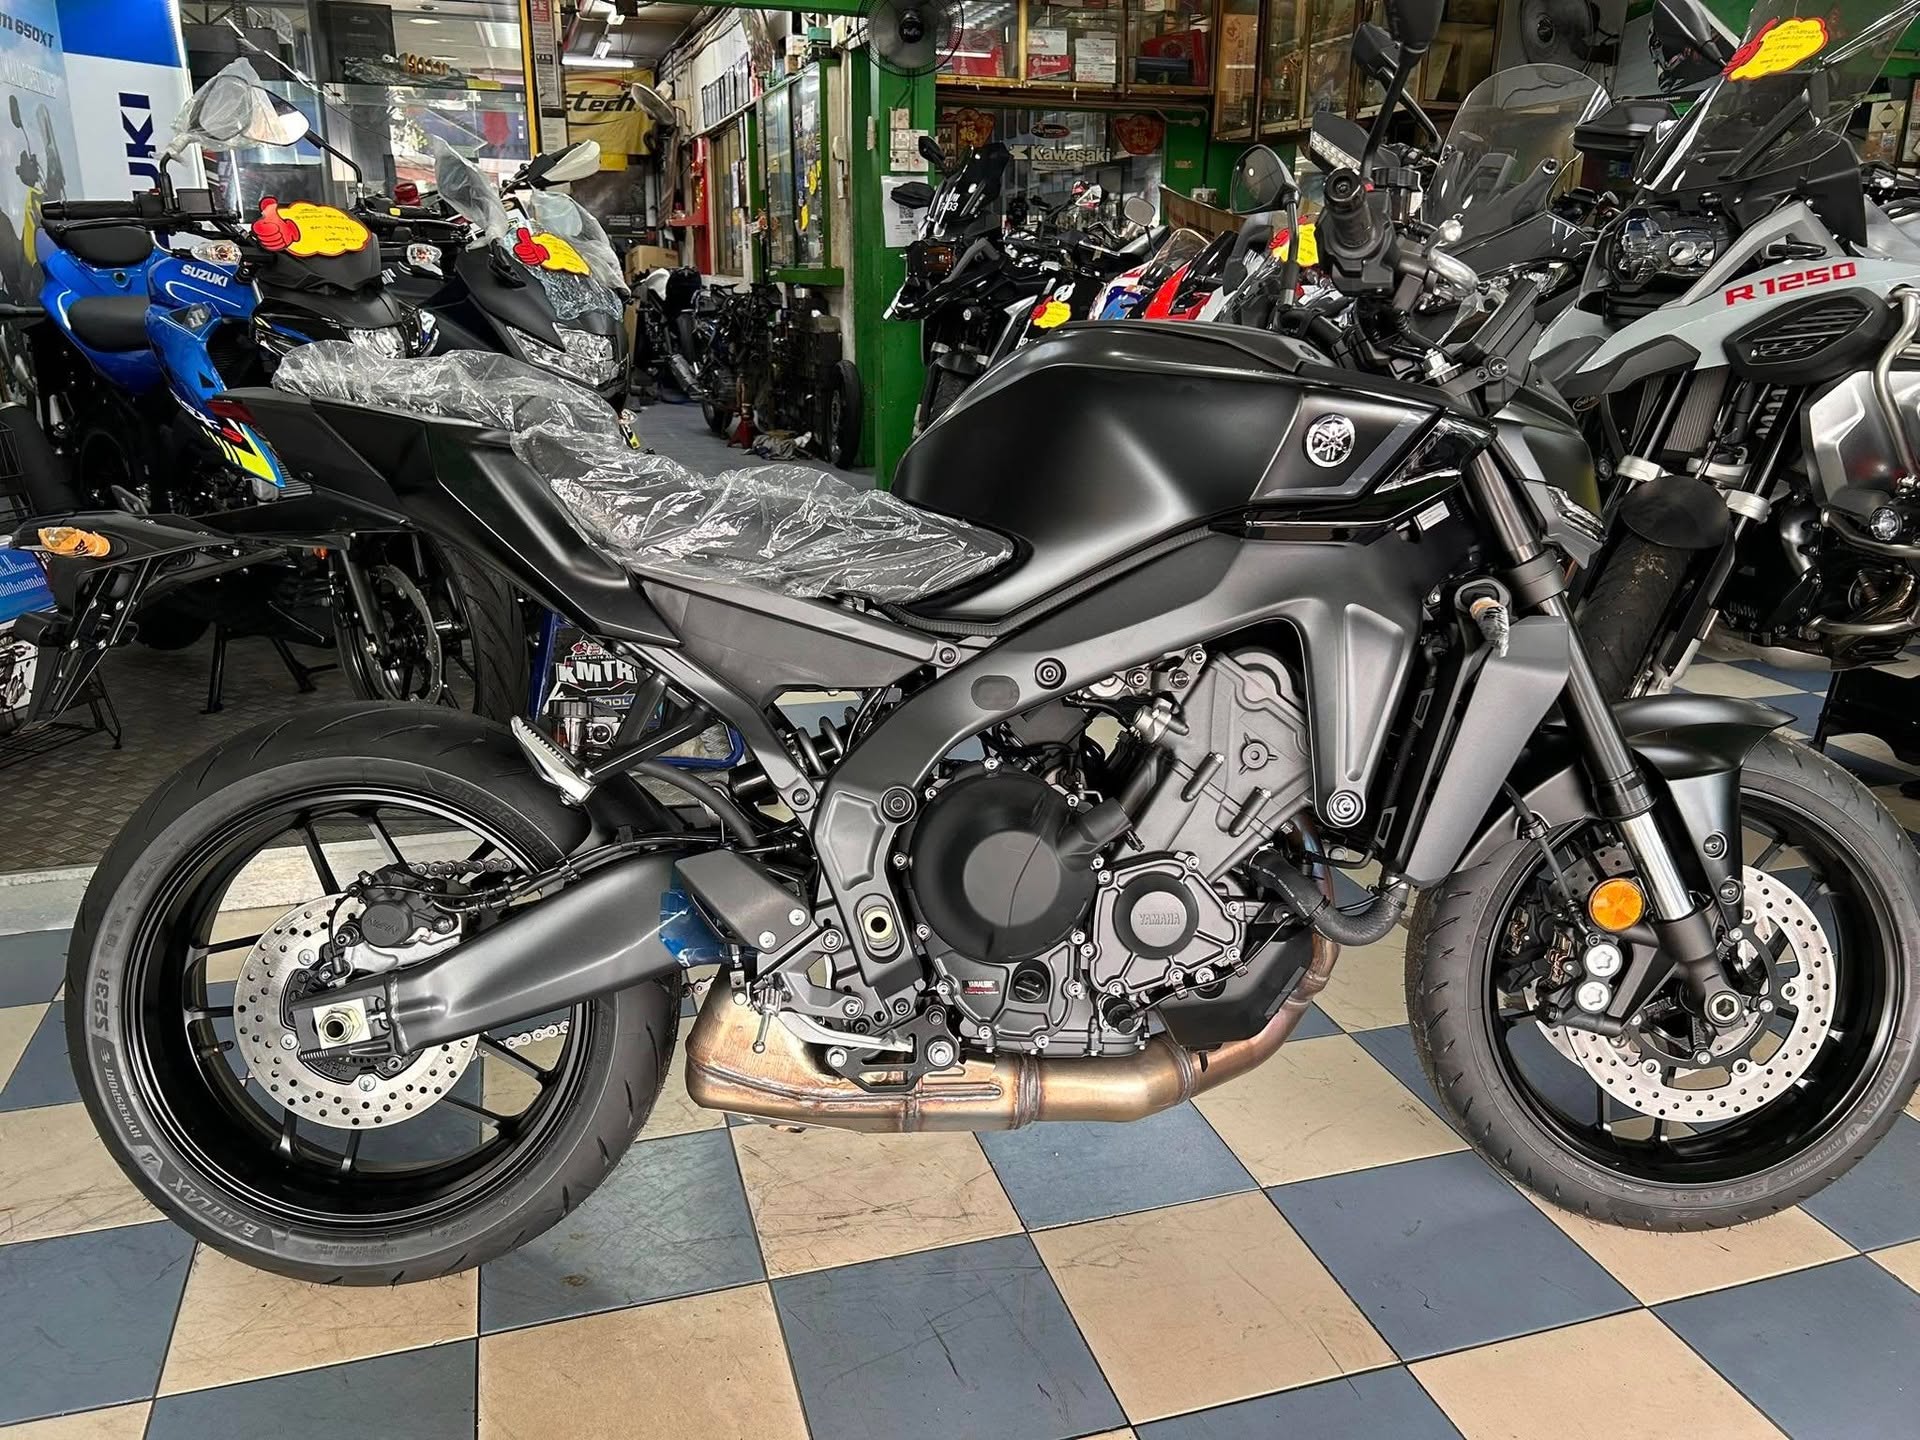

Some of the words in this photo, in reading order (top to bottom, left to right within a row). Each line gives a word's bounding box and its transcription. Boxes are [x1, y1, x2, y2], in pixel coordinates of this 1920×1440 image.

[15, 18, 54, 48] 650XT
[566, 91, 635, 112] tech
[1031, 145, 1110, 162] Kawasaki
[181, 264, 228, 288] SUZUKI
[1725, 284, 1756, 306] R
[1759, 262, 1857, 295] 1250
[558, 659, 635, 685] KMTR
[1139, 912, 1180, 926] YAMAHA
[104, 1067, 143, 1139] HYPERSPORT
[167, 1176, 261, 1238] BATTLAX
